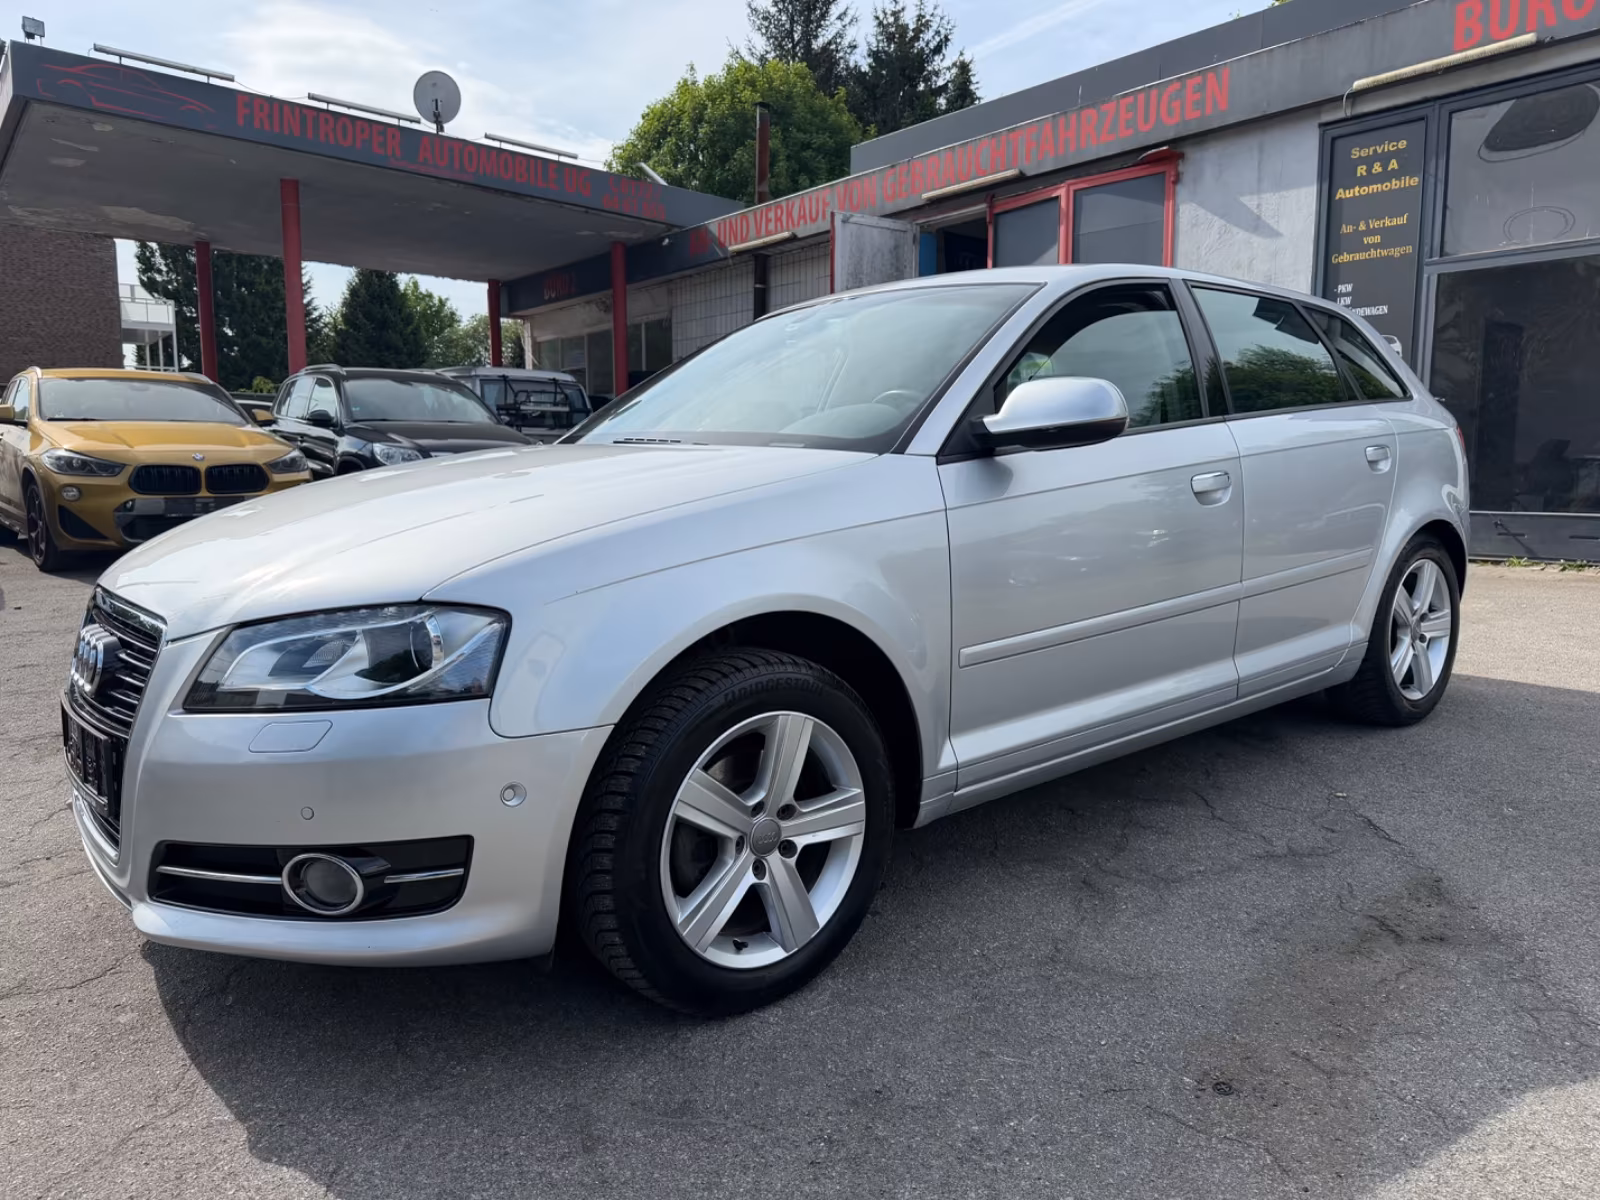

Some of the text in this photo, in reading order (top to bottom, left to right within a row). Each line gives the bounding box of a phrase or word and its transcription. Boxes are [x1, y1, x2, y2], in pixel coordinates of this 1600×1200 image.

[235, 94, 402, 157] FRINTROPER
[418, 136, 559, 191] AUTOMOBILE
[564, 168, 592, 198] UG
[1350, 139, 1408, 159] Service
[717, 216, 750, 249] UND
[753, 189, 832, 238] VERKAUF
[836, 175, 877, 213] VON
[883, 67, 1231, 203] GEBRAUCHTFAHRZEUGEN
[1356, 159, 1399, 177] R & A
[1335, 176, 1419, 200] Automobile
[1340, 213, 1409, 234] An- & Verkauf
[1363, 234, 1381, 245] von
[1331, 245, 1413, 264] Gebrauchtwagen
[1338, 283, 1353, 294] PKW
